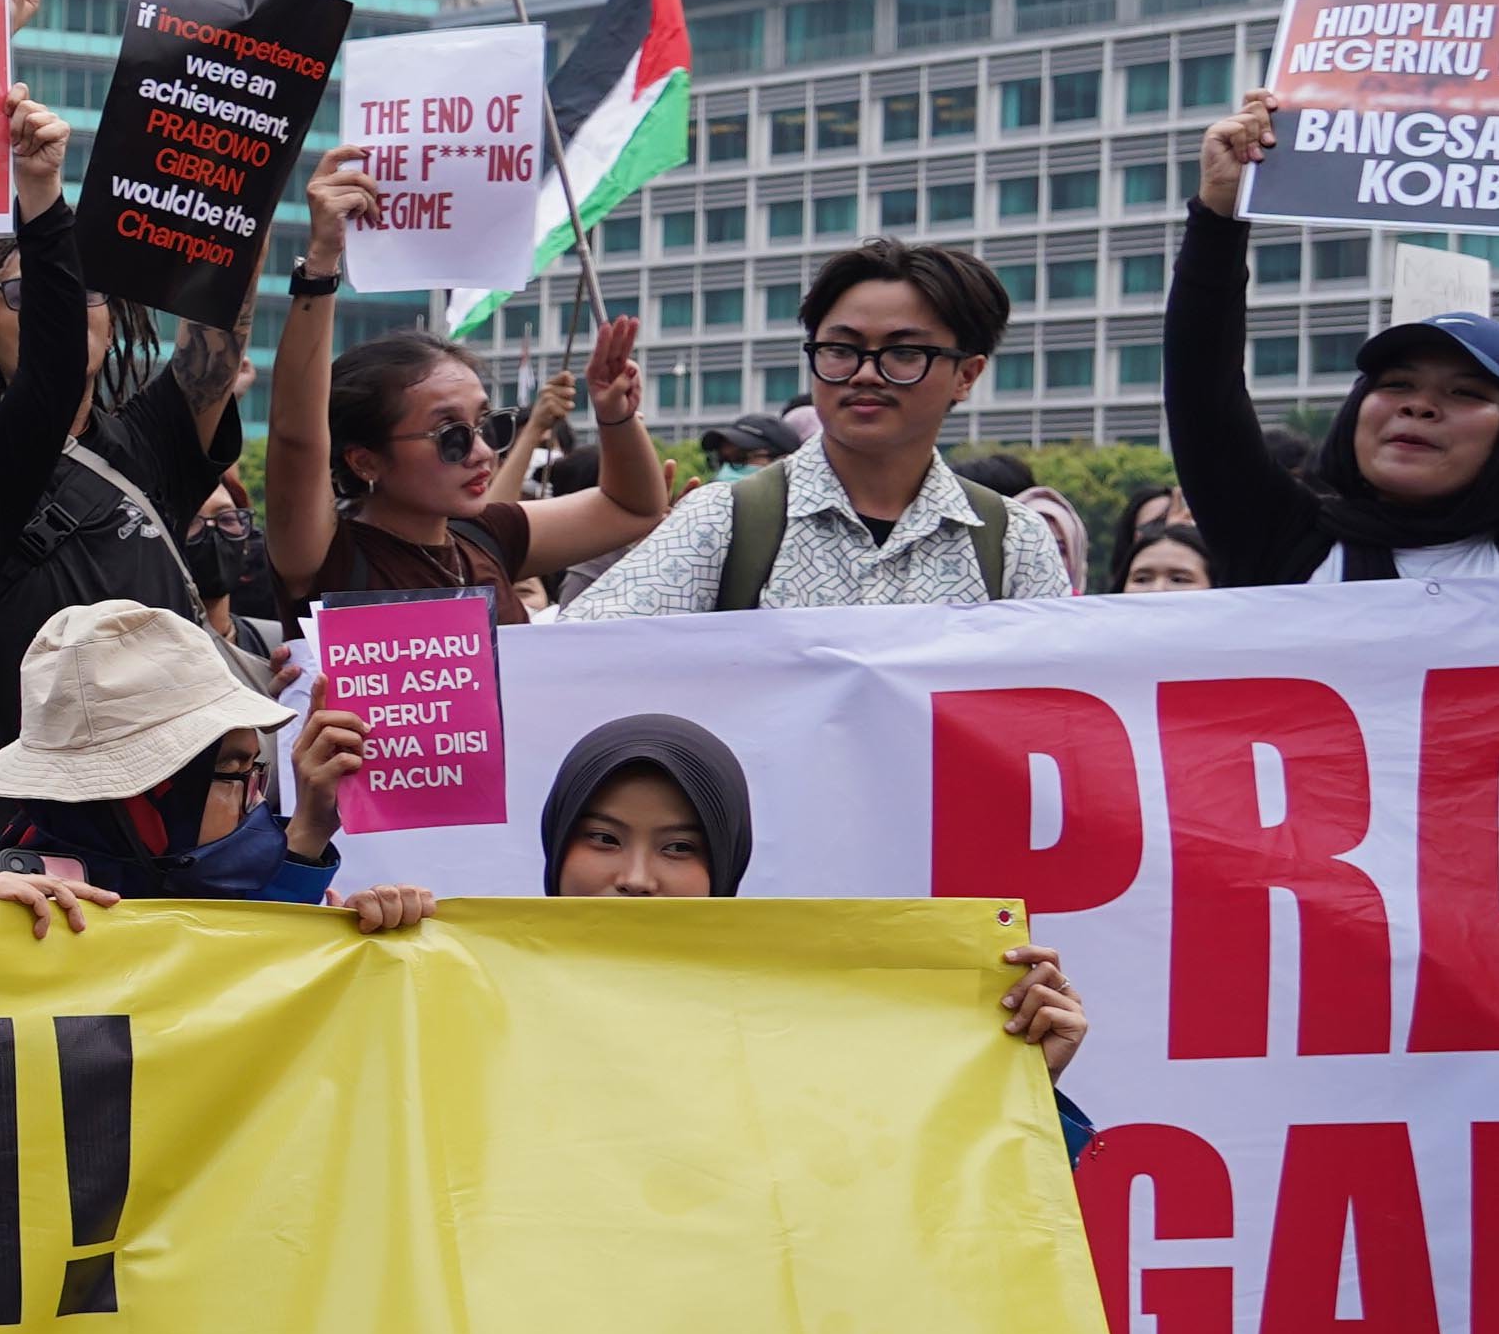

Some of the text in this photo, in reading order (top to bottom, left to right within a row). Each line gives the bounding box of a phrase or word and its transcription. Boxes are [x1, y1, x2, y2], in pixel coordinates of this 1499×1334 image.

[137, 2, 325, 80] if incompetence
[1313, 3, 1496, 39] HIDUPLAH
[186, 54, 277, 99] were an
[1288, 38, 1490, 81] NEGERIKU,
[139, 78, 290, 143] achievement,
[360, 94, 523, 135] THE END OF
[146, 109, 271, 167] PRABOWO
[156, 148, 246, 195] GIBRAN
[360, 145, 409, 182] THE
[111, 175, 256, 237] would be the
[117, 209, 234, 267] Champion
[328, 633, 480, 667] PARU-PARU
[336, 667, 480, 698] DIISI ASAP,
[368, 701, 452, 728] PERUT
[363, 730, 487, 760] SWA DIISI
[369, 765, 462, 792] RACUN
[931, 665, 1499, 1059] PR
